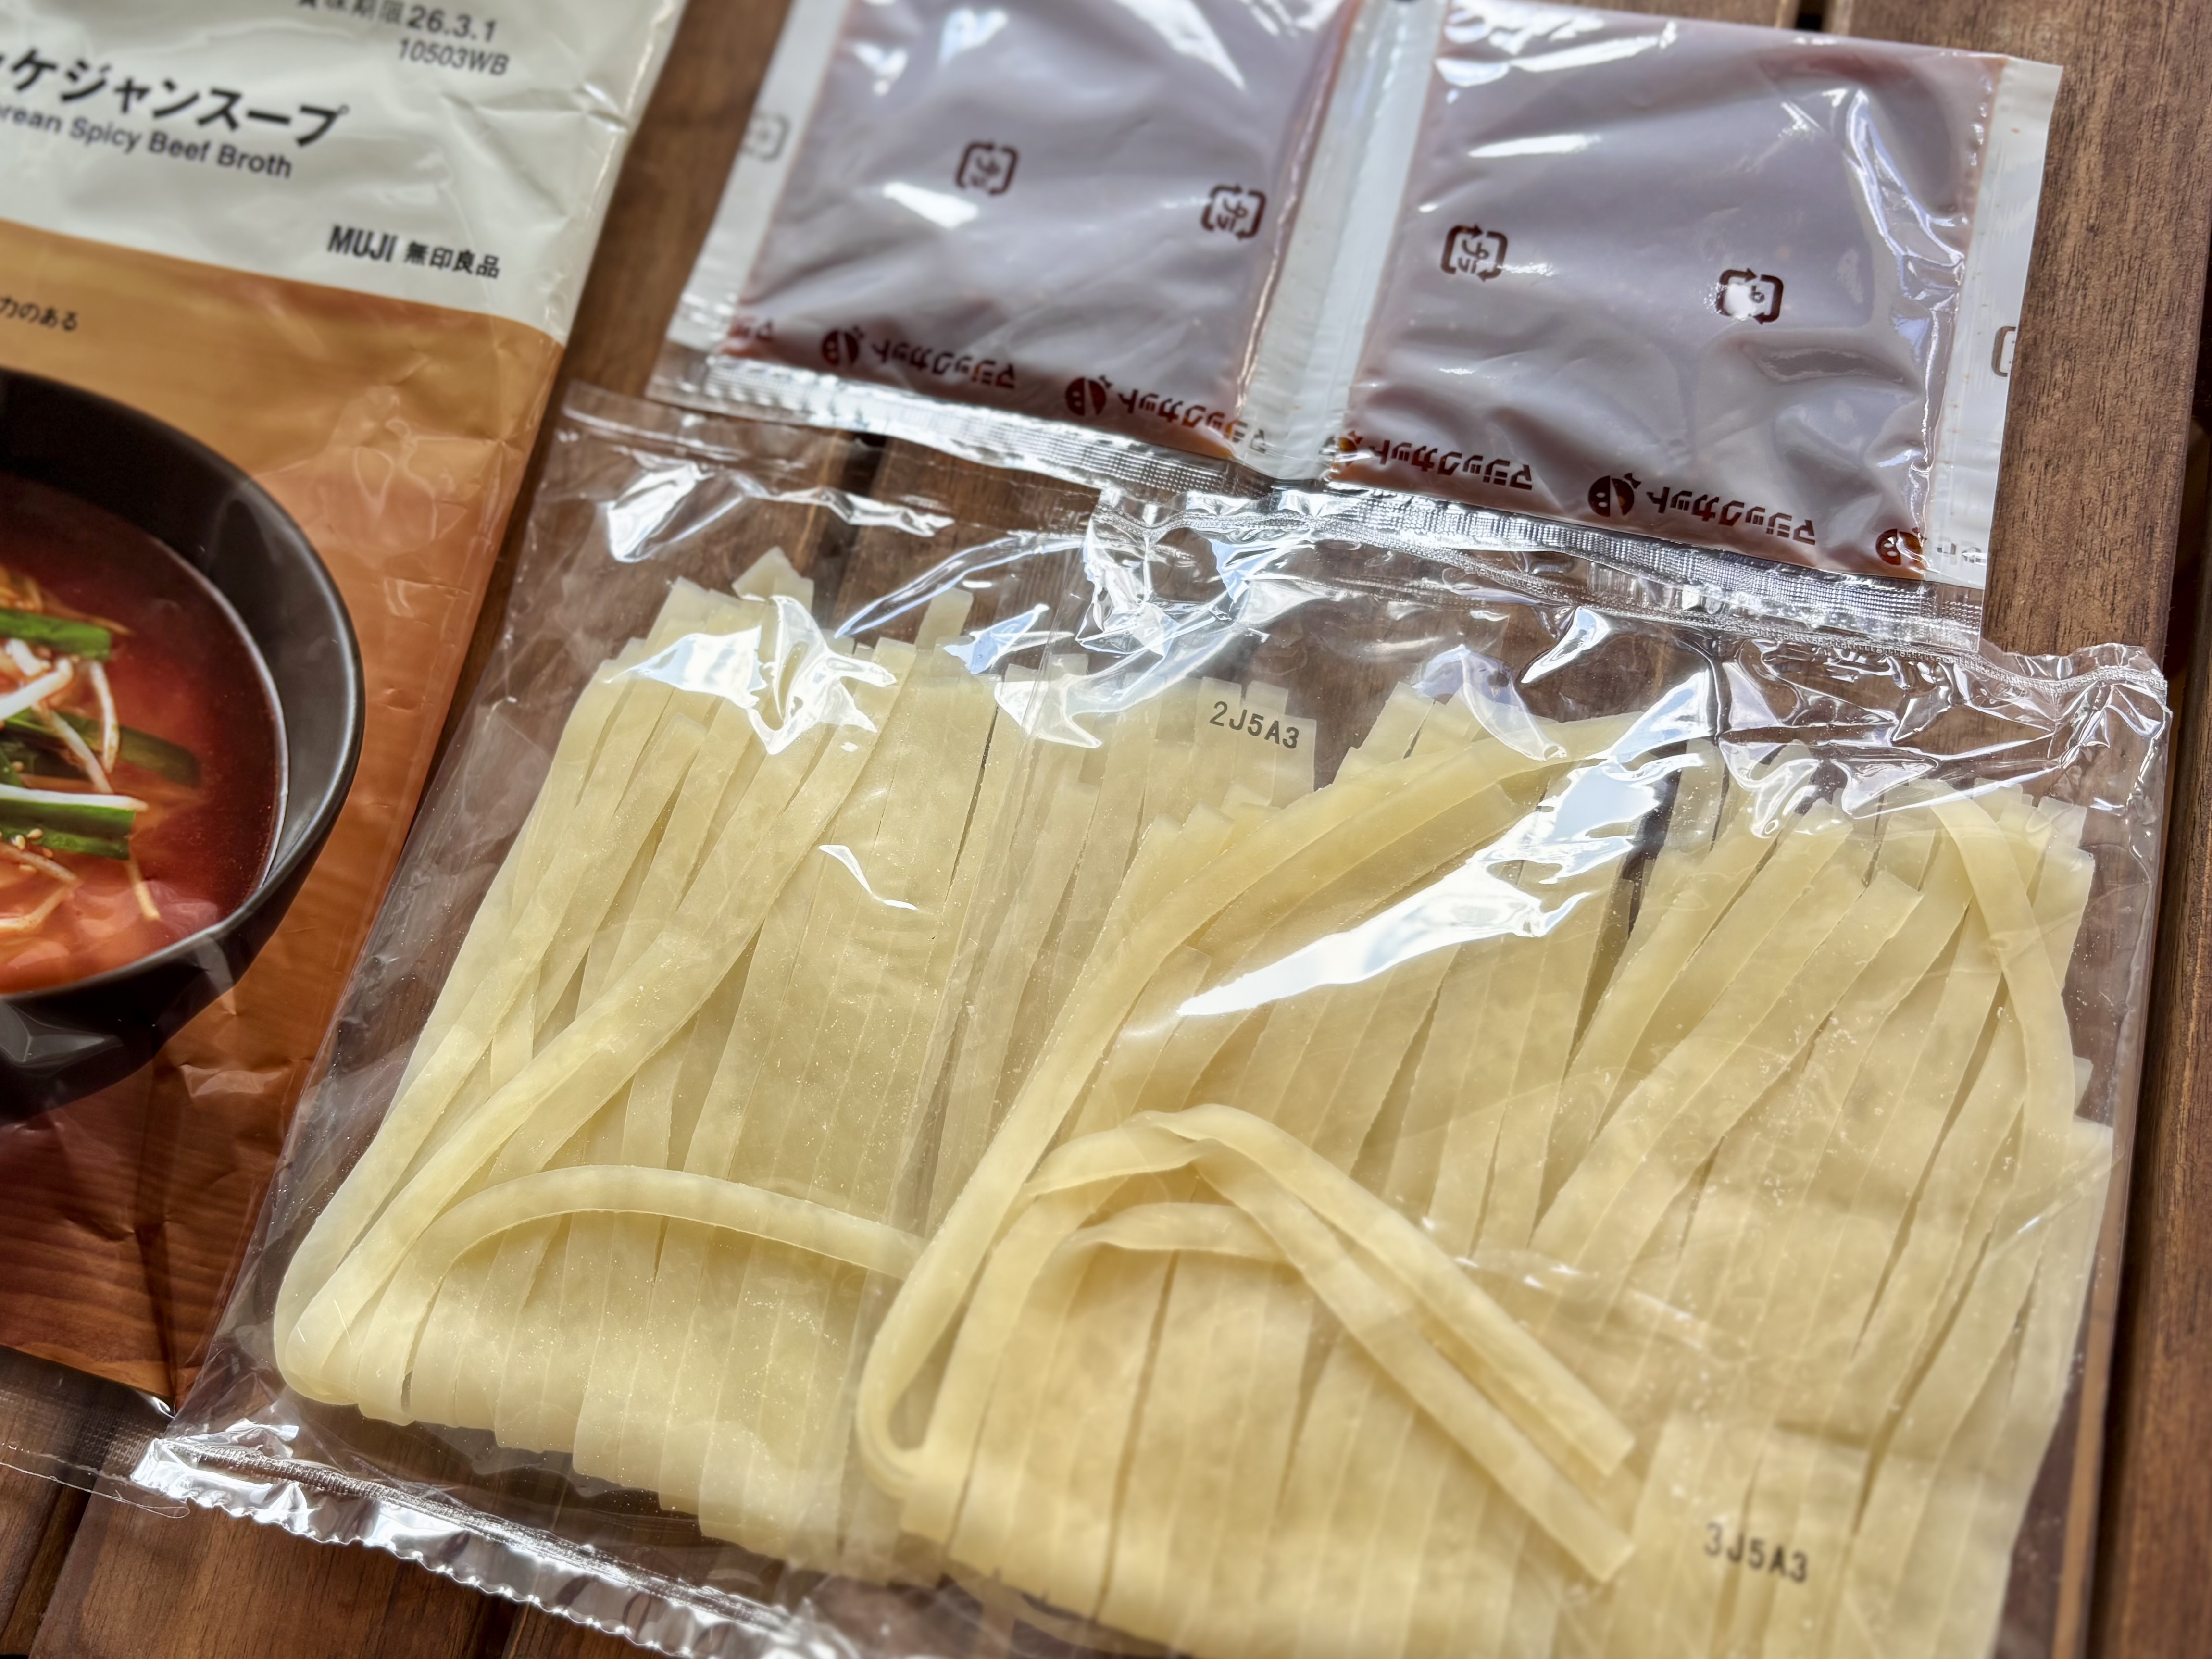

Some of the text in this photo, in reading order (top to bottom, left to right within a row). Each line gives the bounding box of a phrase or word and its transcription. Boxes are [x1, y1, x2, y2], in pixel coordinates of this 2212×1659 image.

[408, 5, 497, 42] 26.3.1
[400, 38, 509, 75] 10503WB
[0, 47, 349, 146] ケジャンスープ
[0, 102, 292, 178] rean Spicy Beef Broth
[328, 225, 500, 279] MUJI 無印良品
[1369, 439, 1532, 490] マジックカット
[1646, 486, 1815, 546] マジックカット
[1209, 700, 1299, 749] 2J5A3
[1704, 1522, 1808, 1584] 3J5A3
